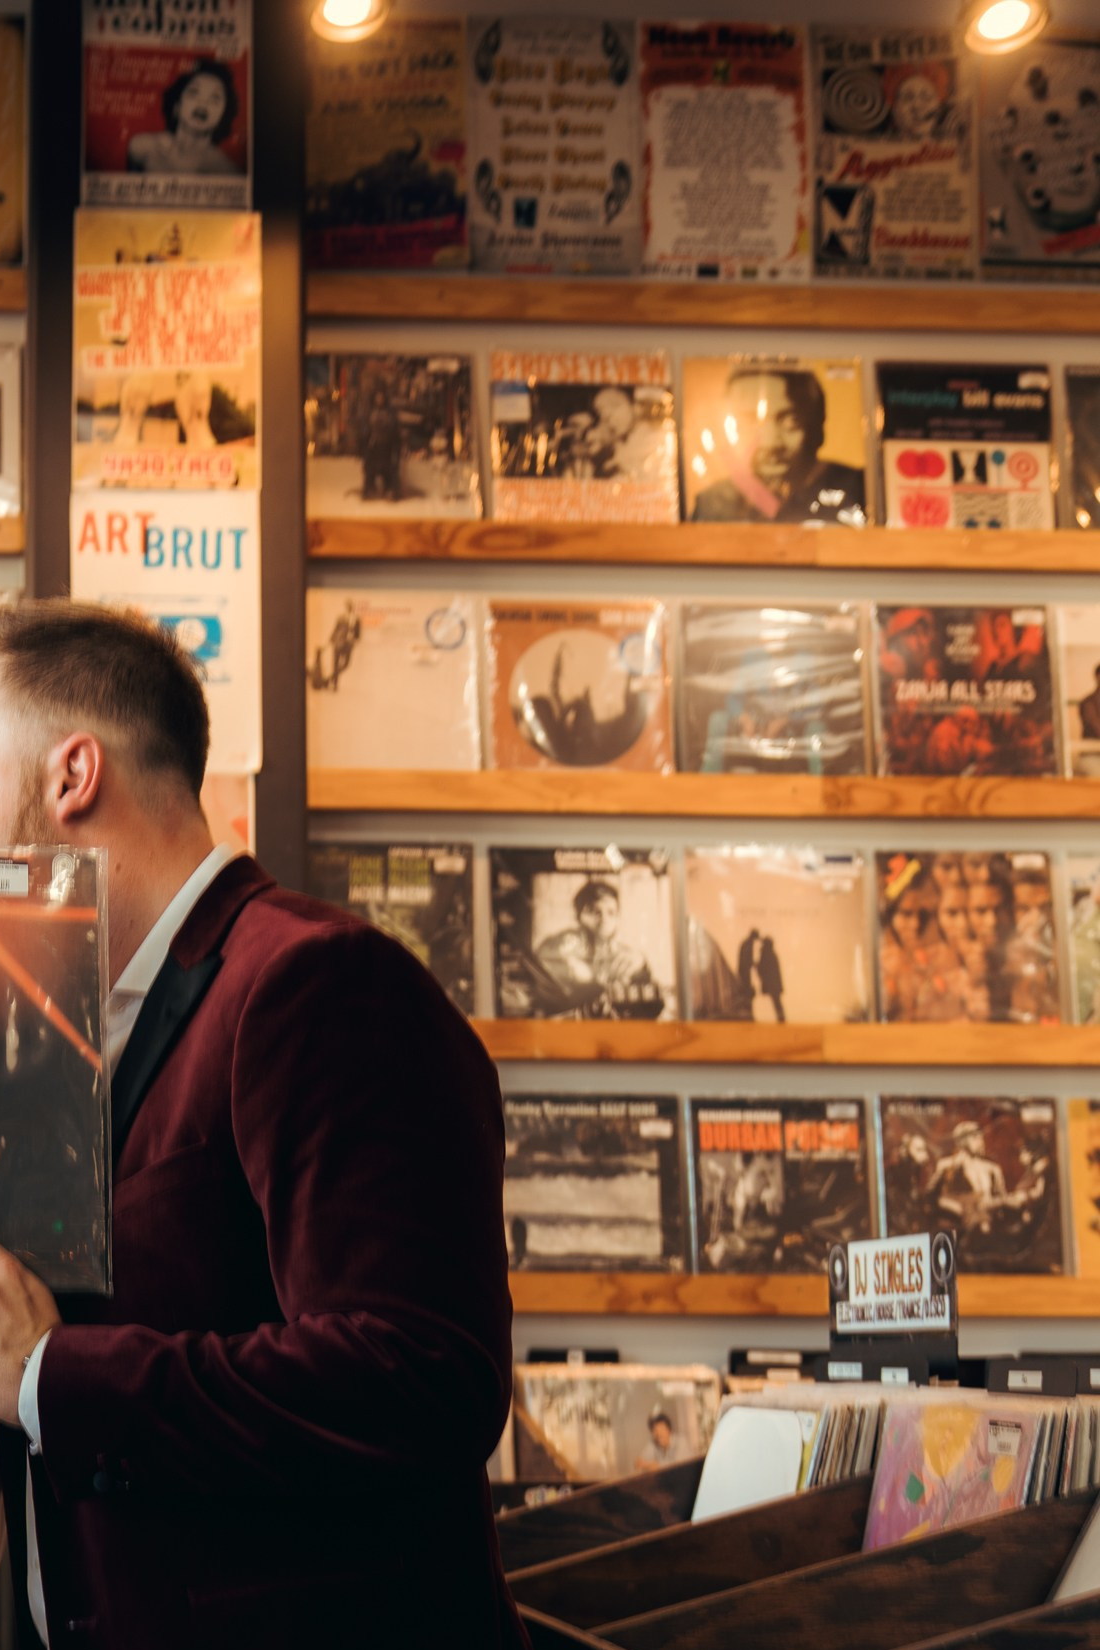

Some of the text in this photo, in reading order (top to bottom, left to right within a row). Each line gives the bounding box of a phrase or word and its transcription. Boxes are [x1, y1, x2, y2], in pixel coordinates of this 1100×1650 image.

[78, 508, 155, 555] ART
[144, 526, 250, 570] BRUT
[855, 1246, 924, 1297] DJ SINGLES
